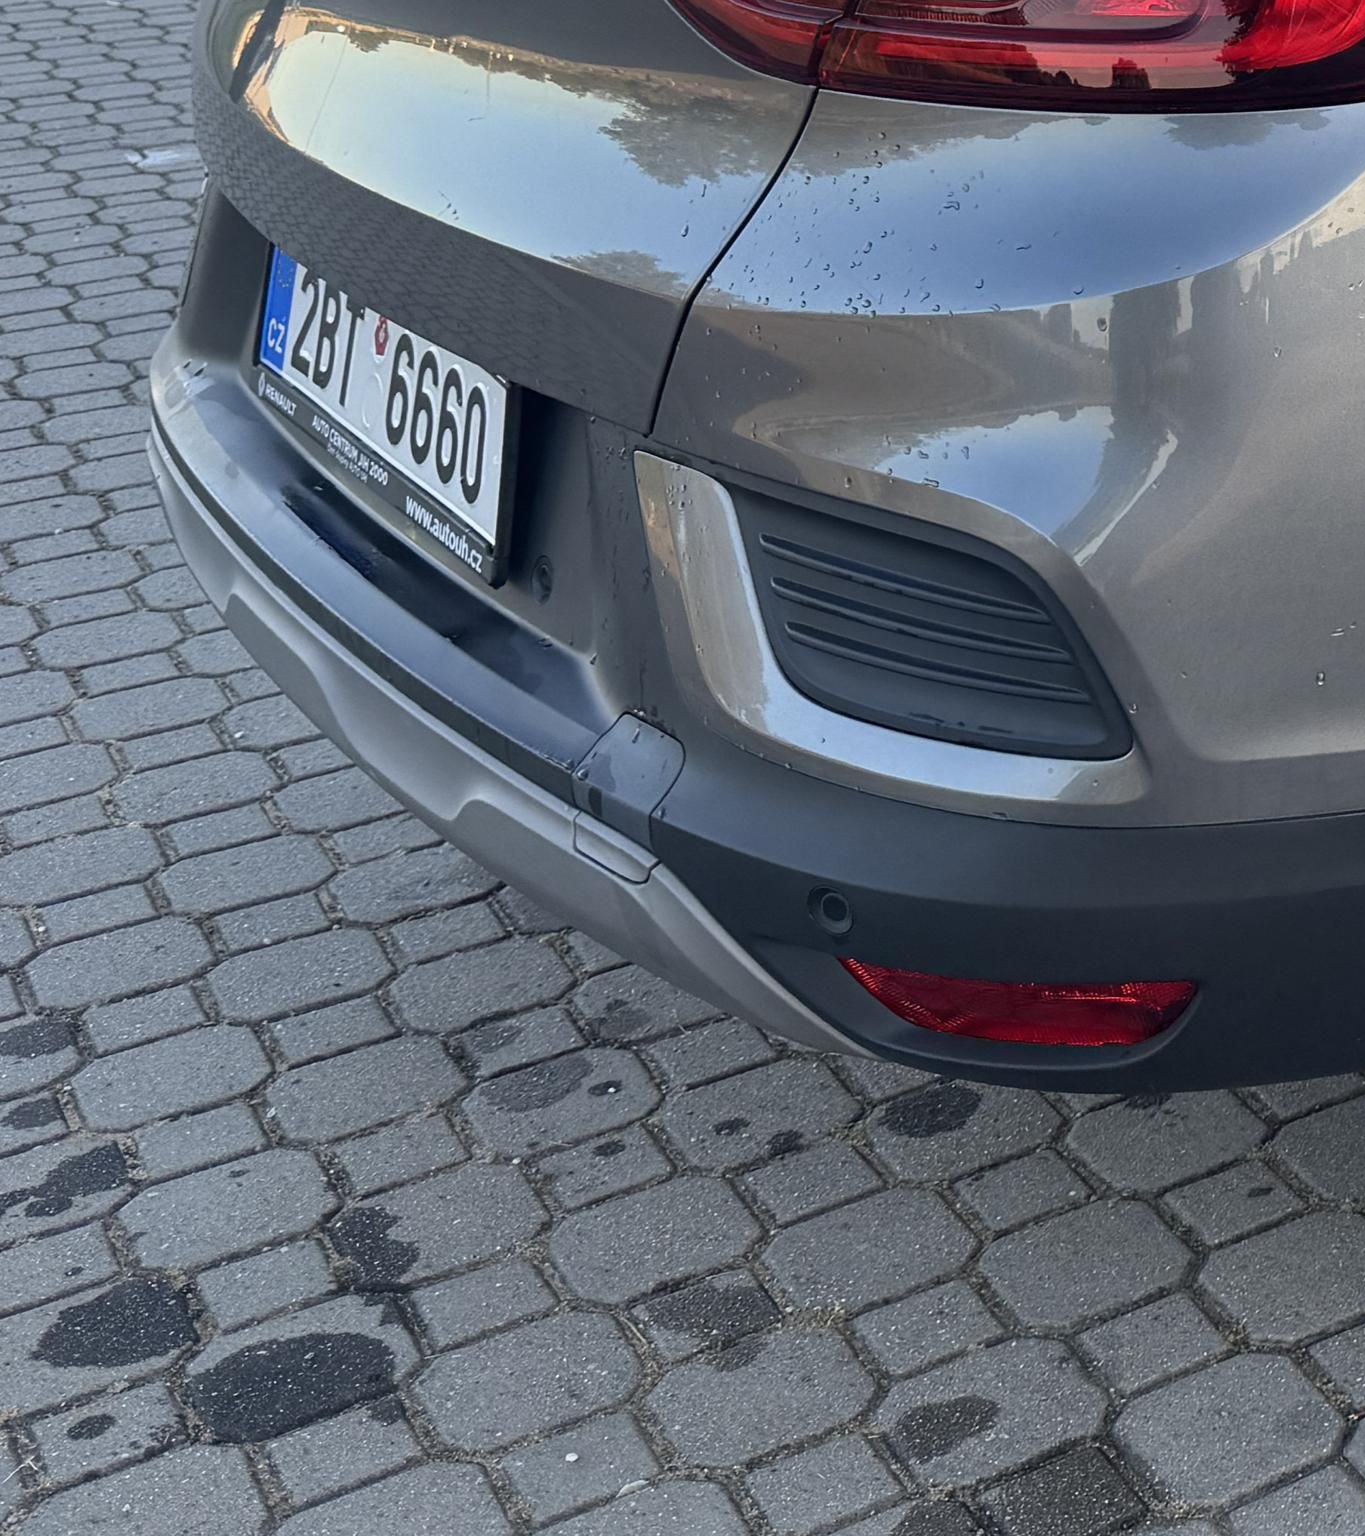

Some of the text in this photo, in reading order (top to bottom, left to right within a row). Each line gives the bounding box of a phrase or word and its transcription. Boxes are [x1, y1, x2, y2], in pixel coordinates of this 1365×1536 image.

[266, 317, 287, 354] CZ
[264, 383, 298, 417] RENAULT
[290, 268, 488, 505] 2BT 6660
[311, 415, 330, 438] AUTO
[405, 494, 483, 574] www.autouh.cz
